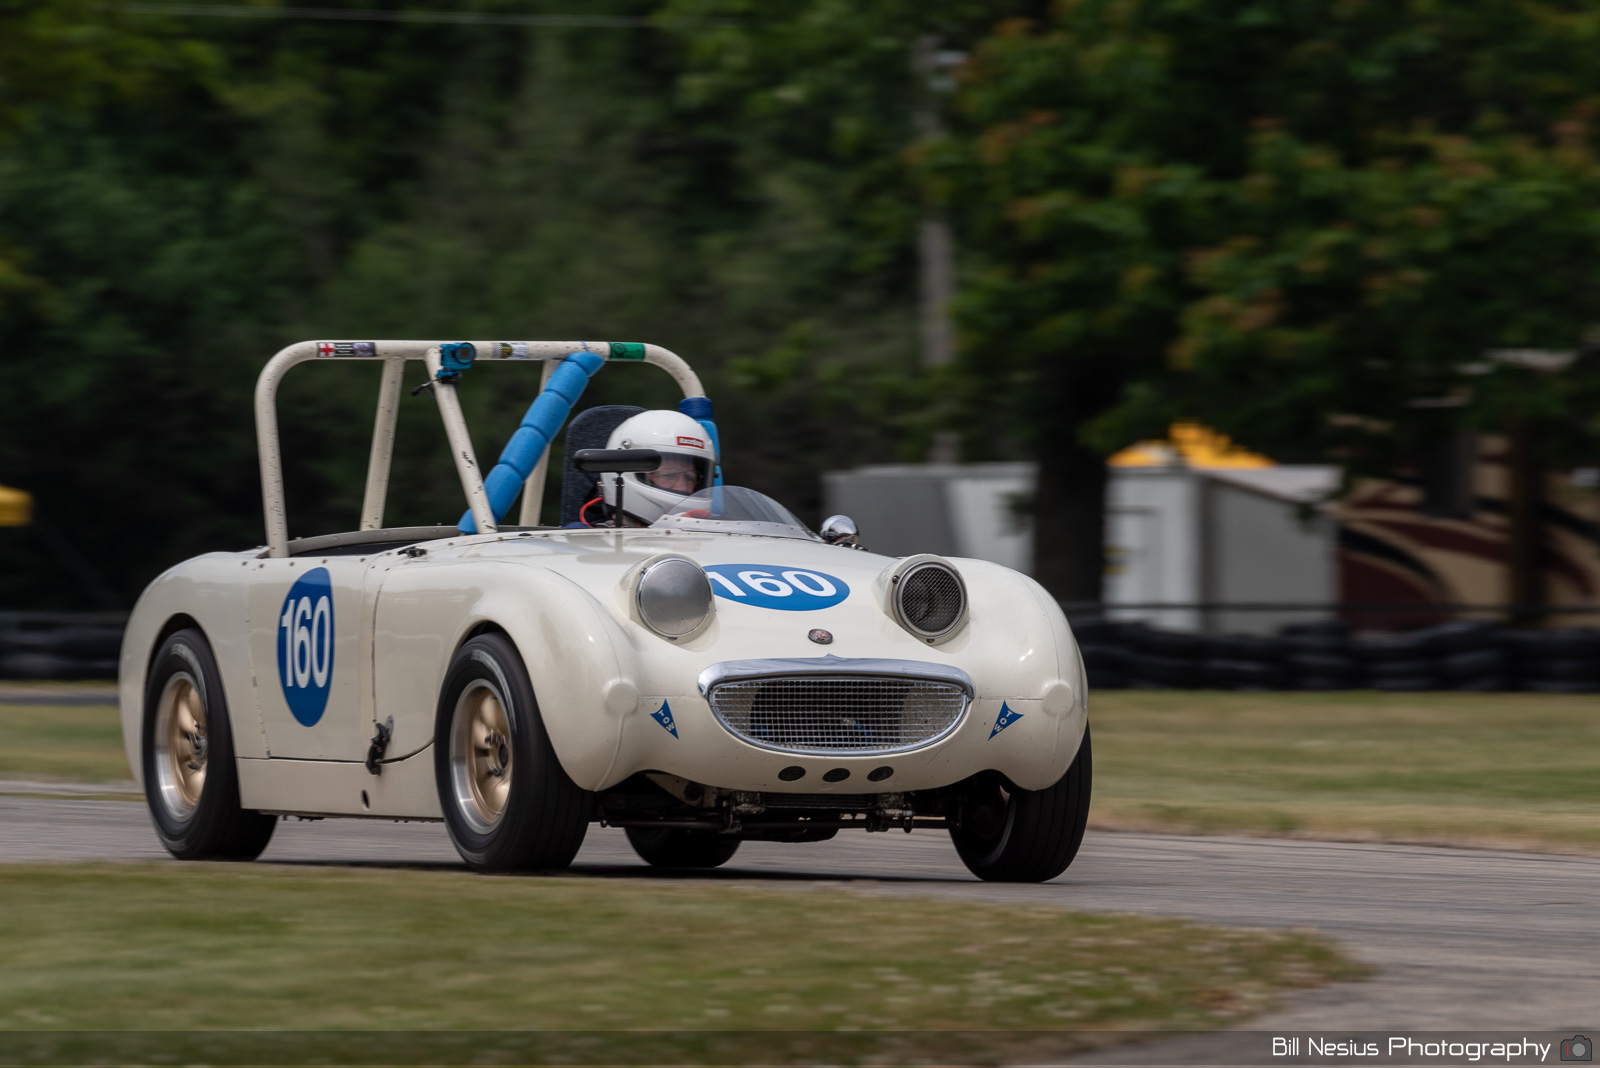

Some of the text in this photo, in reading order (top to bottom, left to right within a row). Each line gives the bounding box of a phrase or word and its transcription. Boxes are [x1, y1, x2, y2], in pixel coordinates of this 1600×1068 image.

[706, 570, 836, 597] 160
[281, 595, 331, 689] 160
[658, 709, 675, 731] TOW
[994, 710, 1013, 732] TOW
